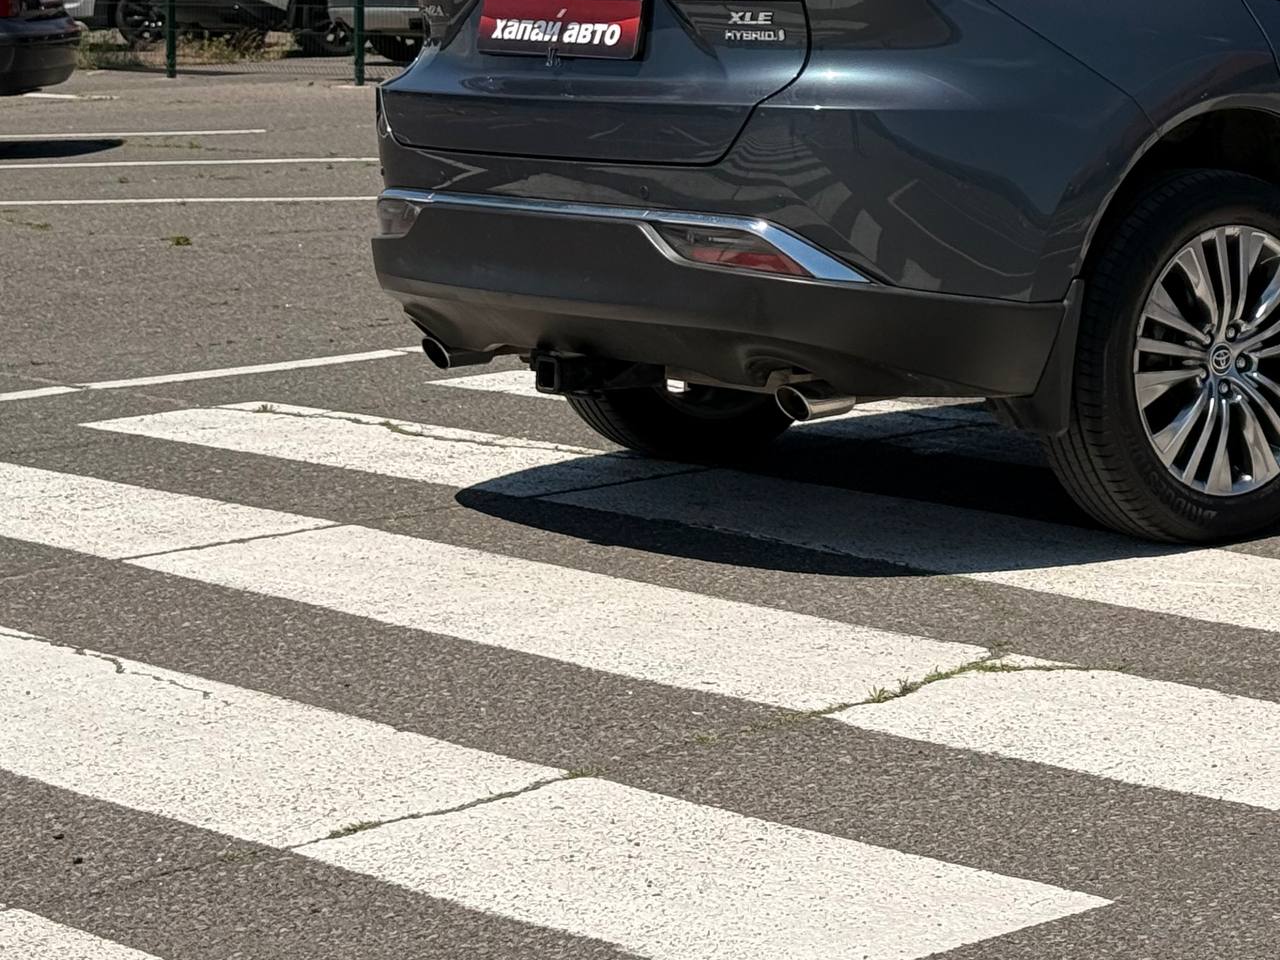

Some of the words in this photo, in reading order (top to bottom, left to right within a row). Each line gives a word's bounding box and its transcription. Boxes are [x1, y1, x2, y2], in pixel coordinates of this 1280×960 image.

[727, 11, 774, 25] XLE
[562, 22, 622, 46] авто
[724, 29, 778, 41] HYBRID
